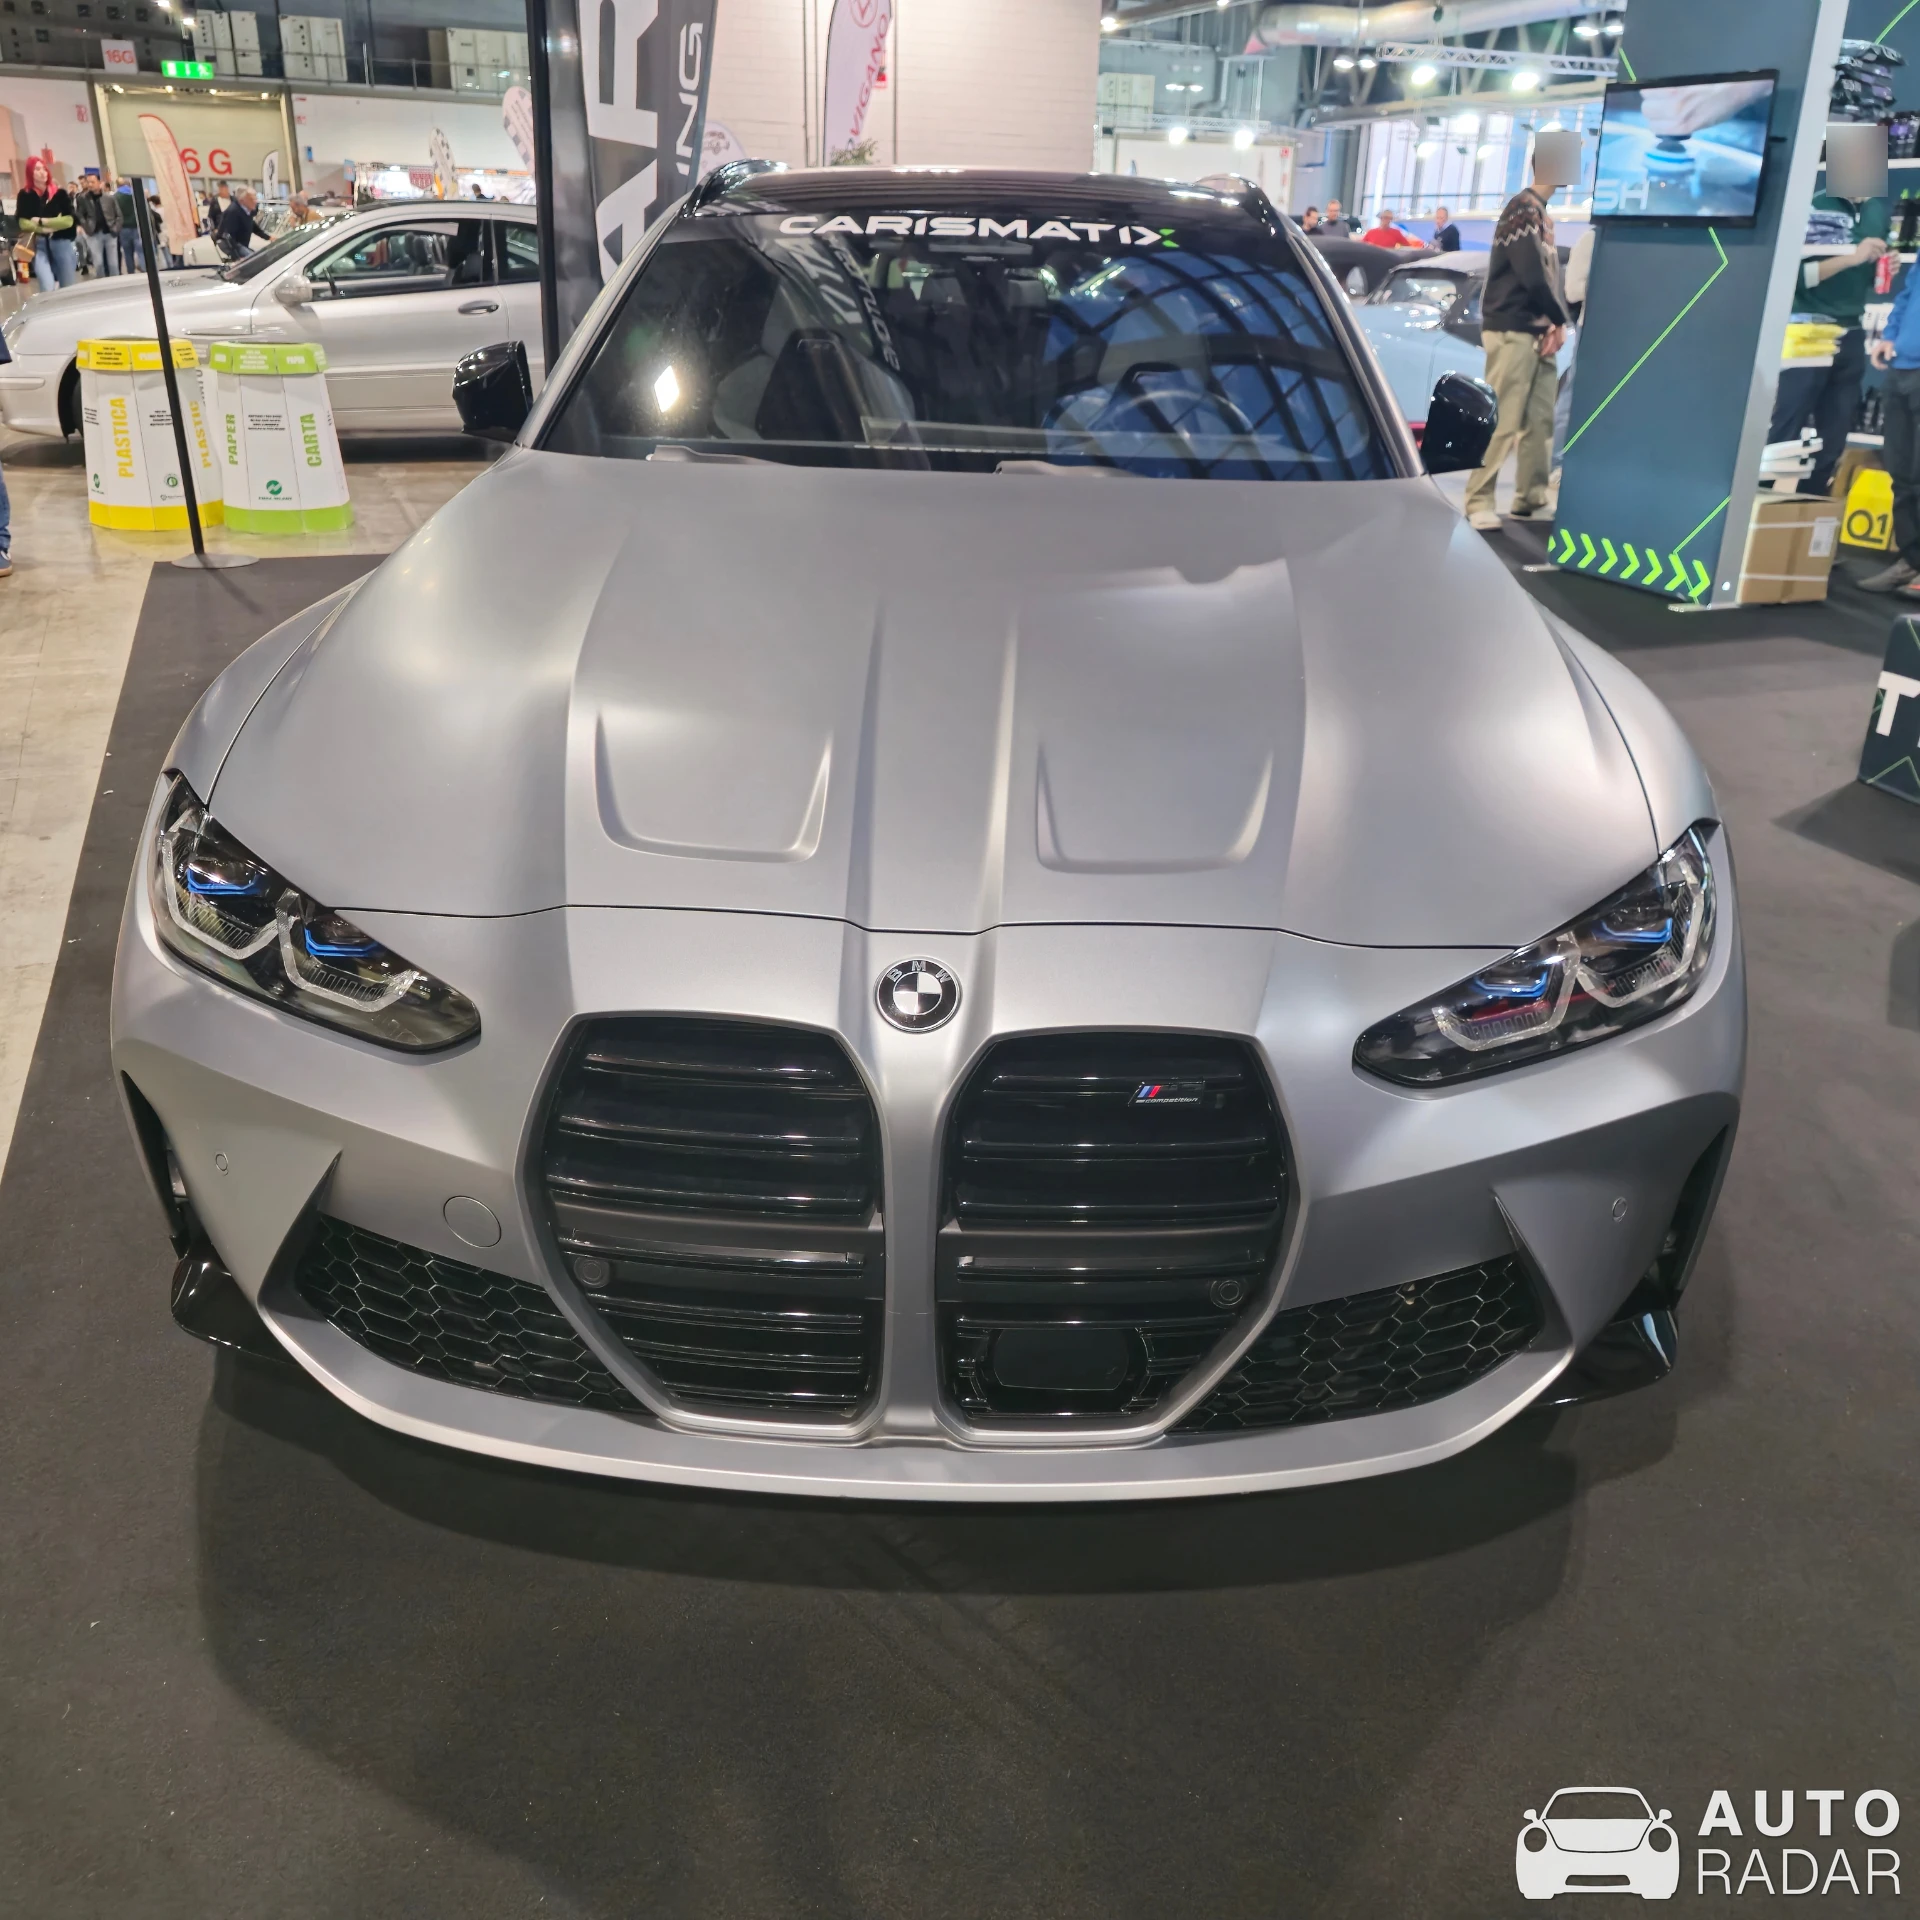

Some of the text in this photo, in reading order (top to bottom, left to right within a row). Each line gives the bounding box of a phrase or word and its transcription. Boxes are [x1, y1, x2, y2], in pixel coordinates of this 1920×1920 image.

[106, 49, 135, 64] 16G
[779, 215, 1180, 248] CARISMATIX
[110, 397, 135, 479] PLASTICA
[225, 413, 239, 466] PAPER
[300, 413, 323, 468] CARTA
[1846, 509, 1889, 544] Q1
[1876, 670, 1920, 749] T
[886, 960, 953, 983] BMW
